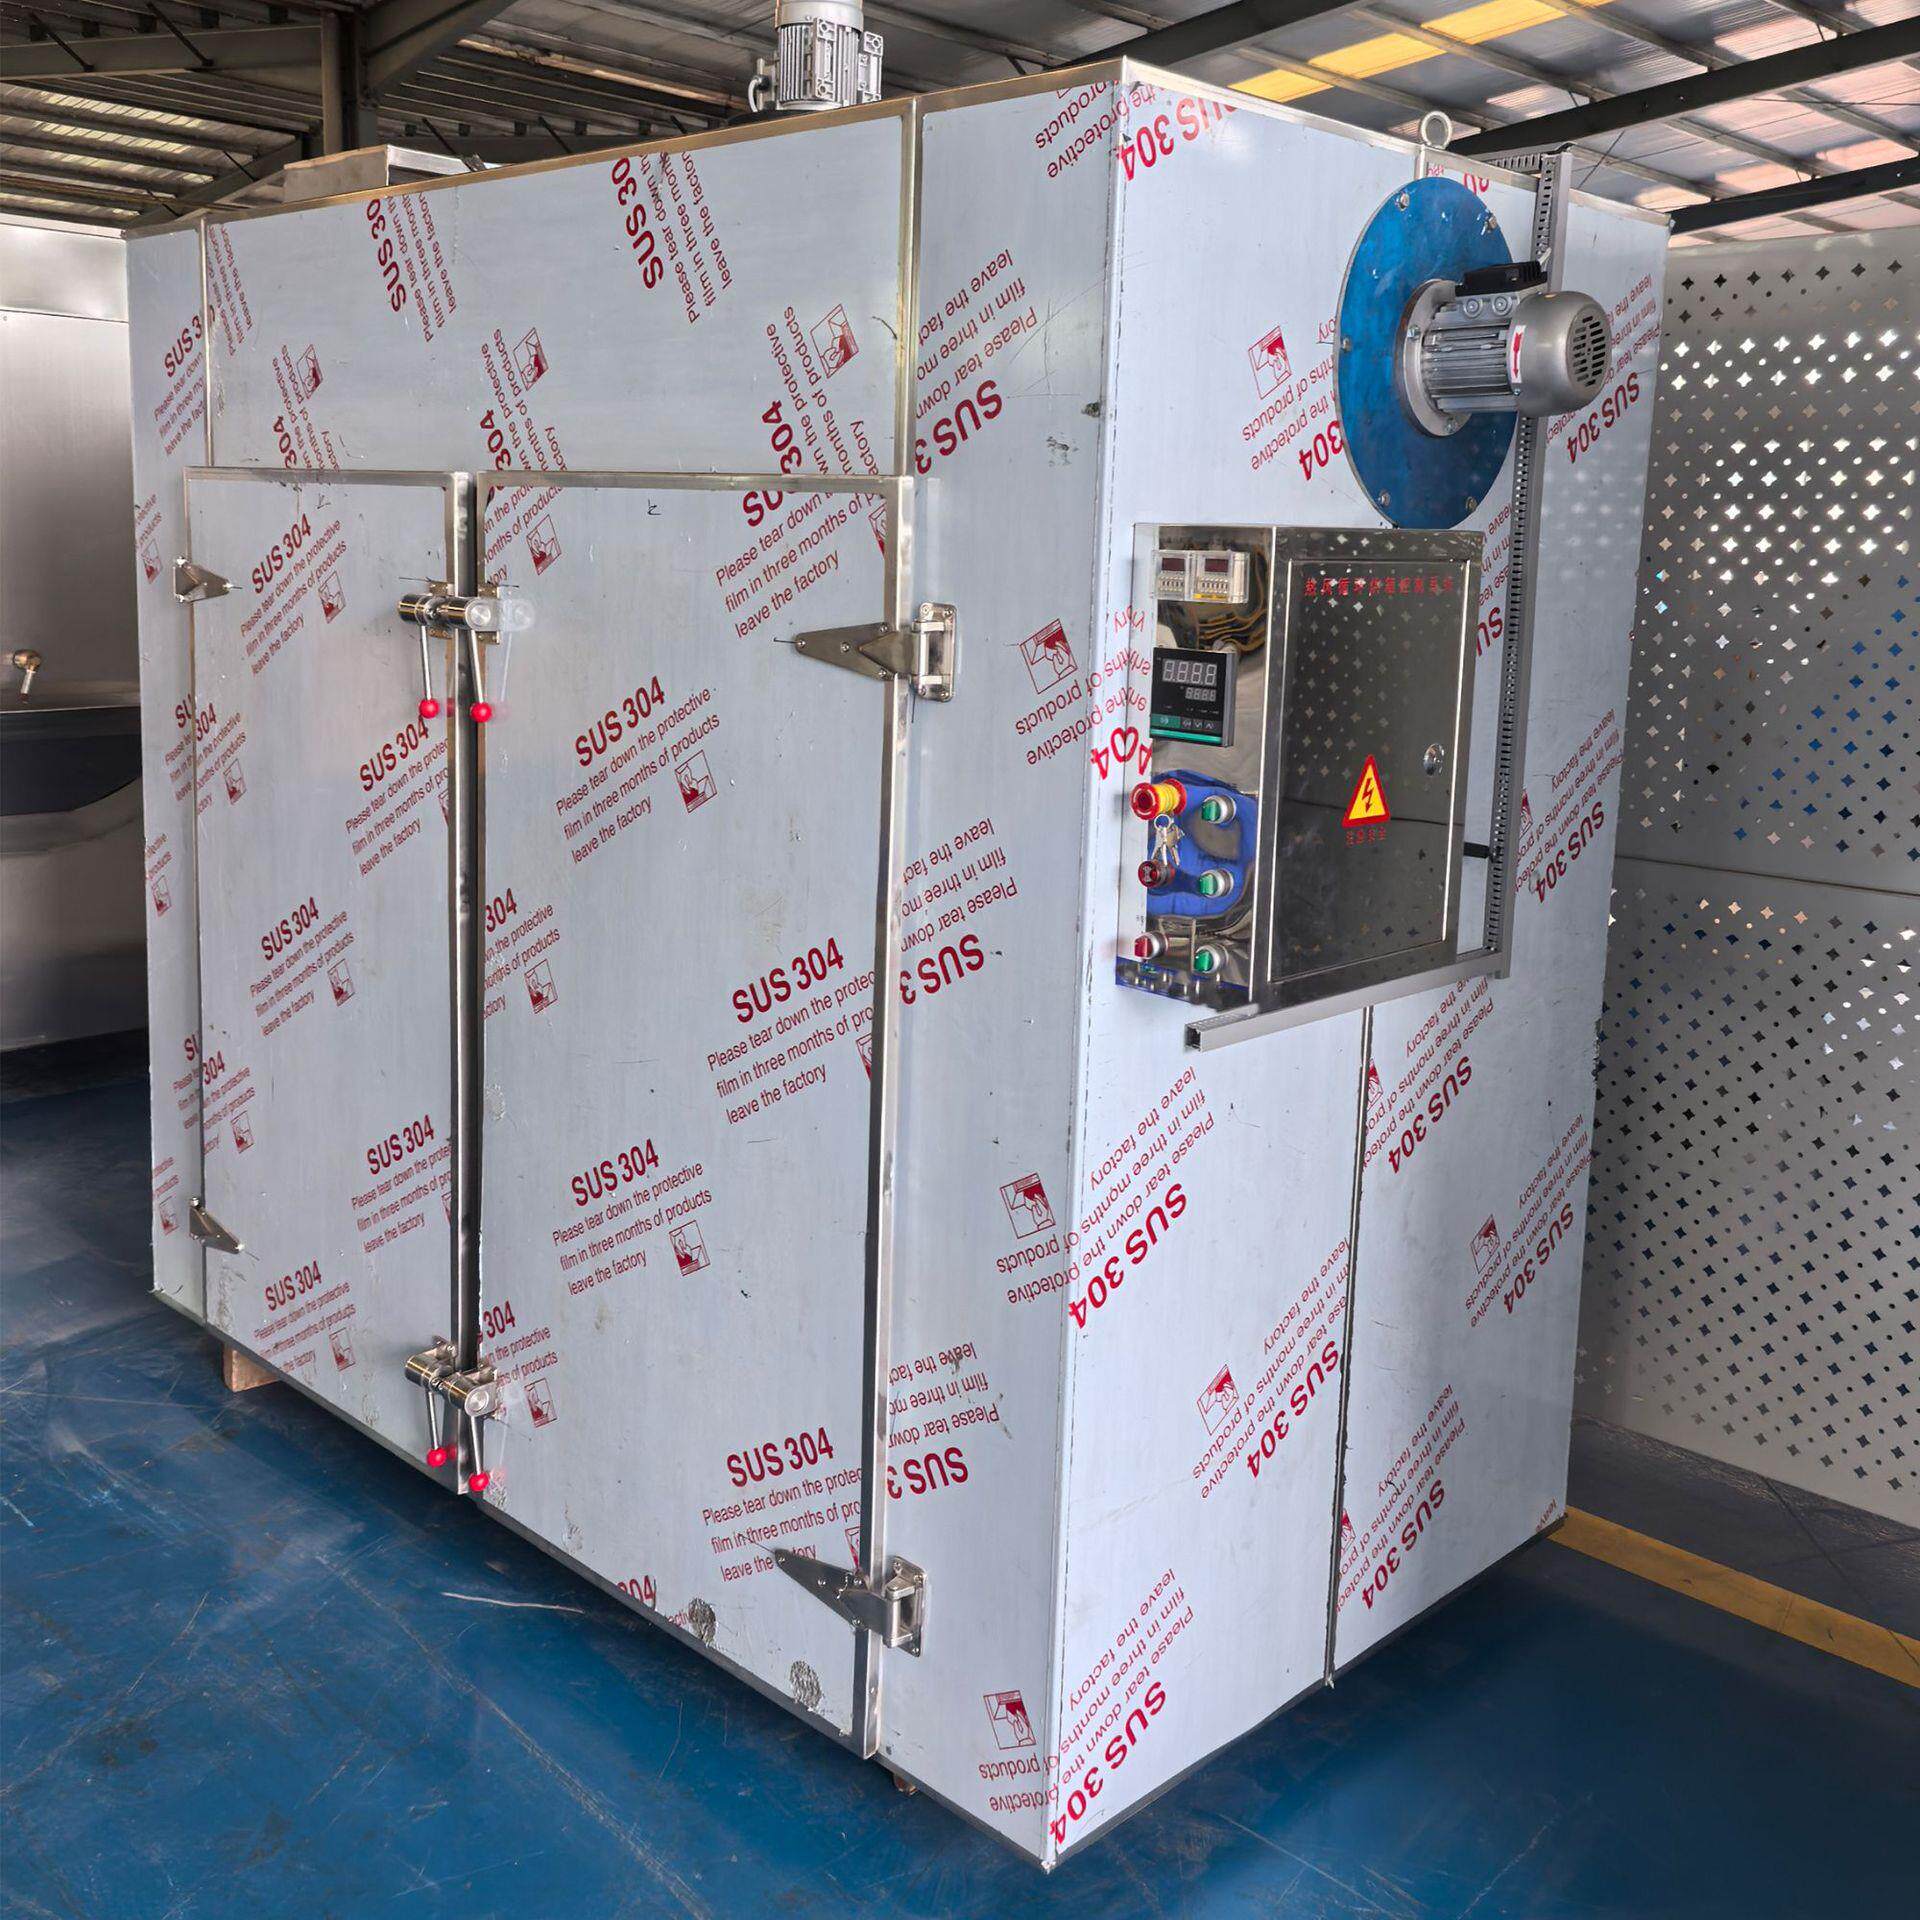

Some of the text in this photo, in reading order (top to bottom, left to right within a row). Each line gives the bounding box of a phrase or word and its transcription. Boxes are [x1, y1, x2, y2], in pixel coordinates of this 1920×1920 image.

[1117, 114, 1175, 181] 304
[377, 238, 407, 312] SUS
[626, 203, 664, 289] SUS
[647, 174, 700, 324] Please tear down
[680, 214, 716, 307] film in three
[699, 206, 733, 290] leave the
[945, 249, 1013, 317] leave the
[164, 327, 193, 378] SUS
[784, 306, 827, 408] of products
[940, 277, 1025, 359] film in three
[954, 306, 1037, 386] Please tear
[481, 343, 522, 449] the protective
[493, 329, 528, 416] of products
[766, 323, 817, 447] the protective
[932, 379, 1003, 457] SUS
[1251, 395, 1329, 470] the protective
[1567, 372, 1640, 464] SUS 304
[252, 513, 311, 594] SUS 304
[716, 494, 822, 587] Please tear down
[725, 509, 847, 613] film in three months
[735, 550, 839, 638] leave the factory
[575, 675, 665, 767] SUS 304
[1015, 681, 1082, 735] products
[360, 743, 397, 792] SUS
[556, 688, 711, 816] Please tear down the protective
[563, 714, 720, 840] film in three months of products
[359, 818, 421, 877] leave the factory
[571, 796, 651, 864] leave the factory
[929, 818, 994, 865] leave the
[1535, 801, 1604, 903] SUS 304
[924, 847, 1006, 903] film in three
[938, 876, 1018, 932] Please tear
[261, 896, 319, 961] SUS 304
[917, 934, 984, 994] SUS
[732, 937, 844, 1023] SUS 304
[707, 995, 833, 1072] Please tear down the
[716, 1015, 850, 1098] film in three months of
[726, 1064, 826, 1125] leave the factory
[1091, 1066, 1196, 1191] leave the factory
[1388, 1056, 1472, 1174] SUS 304
[367, 1114, 434, 1175] SUS 304
[571, 1138, 659, 1206] SUS 304
[552, 1163, 703, 1246] Please tear down the protective
[1082, 1111, 1214, 1267] Please tear down the
[265, 1260, 322, 1312] SUS 304
[996, 1235, 1060, 1274] products
[1007, 1262, 1080, 1304] protective
[1068, 1183, 1187, 1329] SUS 304
[1503, 1203, 1574, 1314] SUS 304
[1201, 1324, 1327, 1499] tear down the protective
[1247, 1340, 1339, 1478] SUS 304
[727, 1427, 834, 1487] SUS 304
[903, 1447, 968, 1494] SUS
[702, 1477, 823, 1526] Please tear down the
[1362, 1479, 1445, 1610] SUS 304
[1070, 1568, 1176, 1711] leave the factory
[1049, 1681, 1166, 1844] SUS 304
